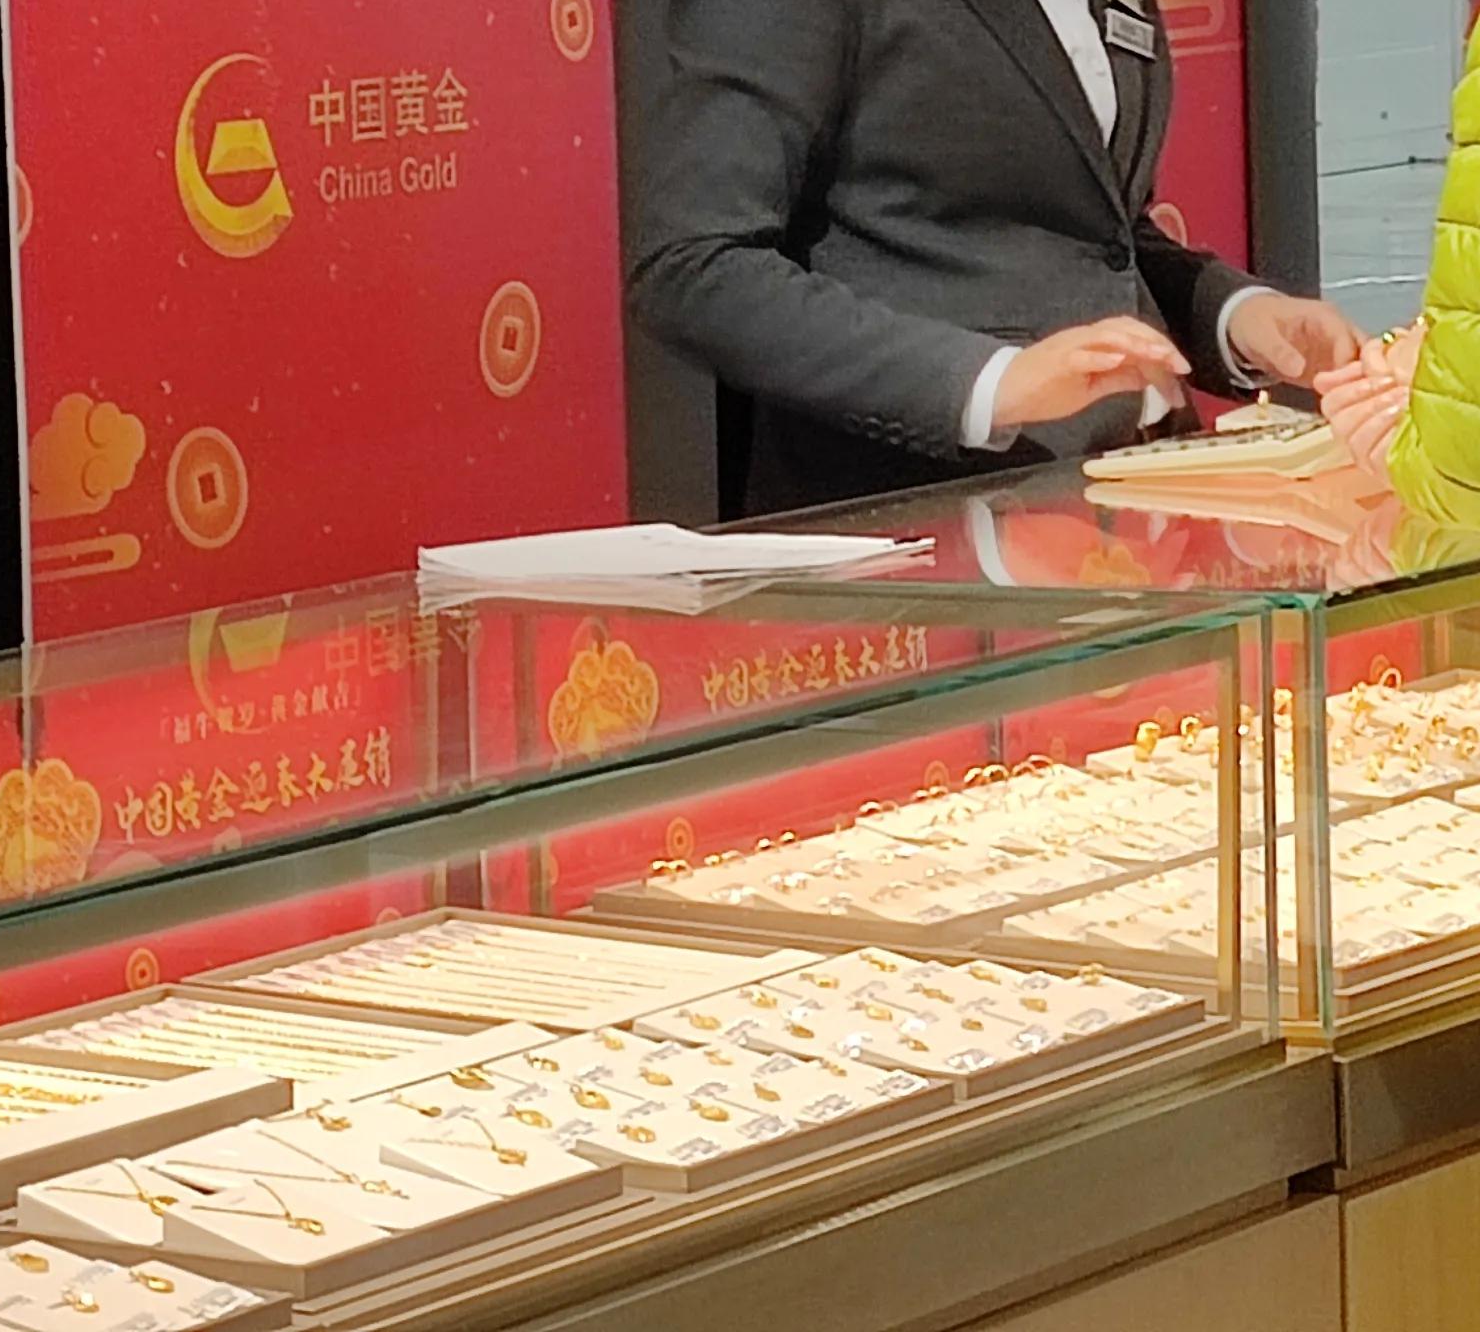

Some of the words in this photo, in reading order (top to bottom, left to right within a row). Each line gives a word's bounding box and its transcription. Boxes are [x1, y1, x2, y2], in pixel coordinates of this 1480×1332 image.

[307, 67, 472, 148] 中国黄金
[318, 163, 393, 205] China
[398, 152, 459, 194] Gold
